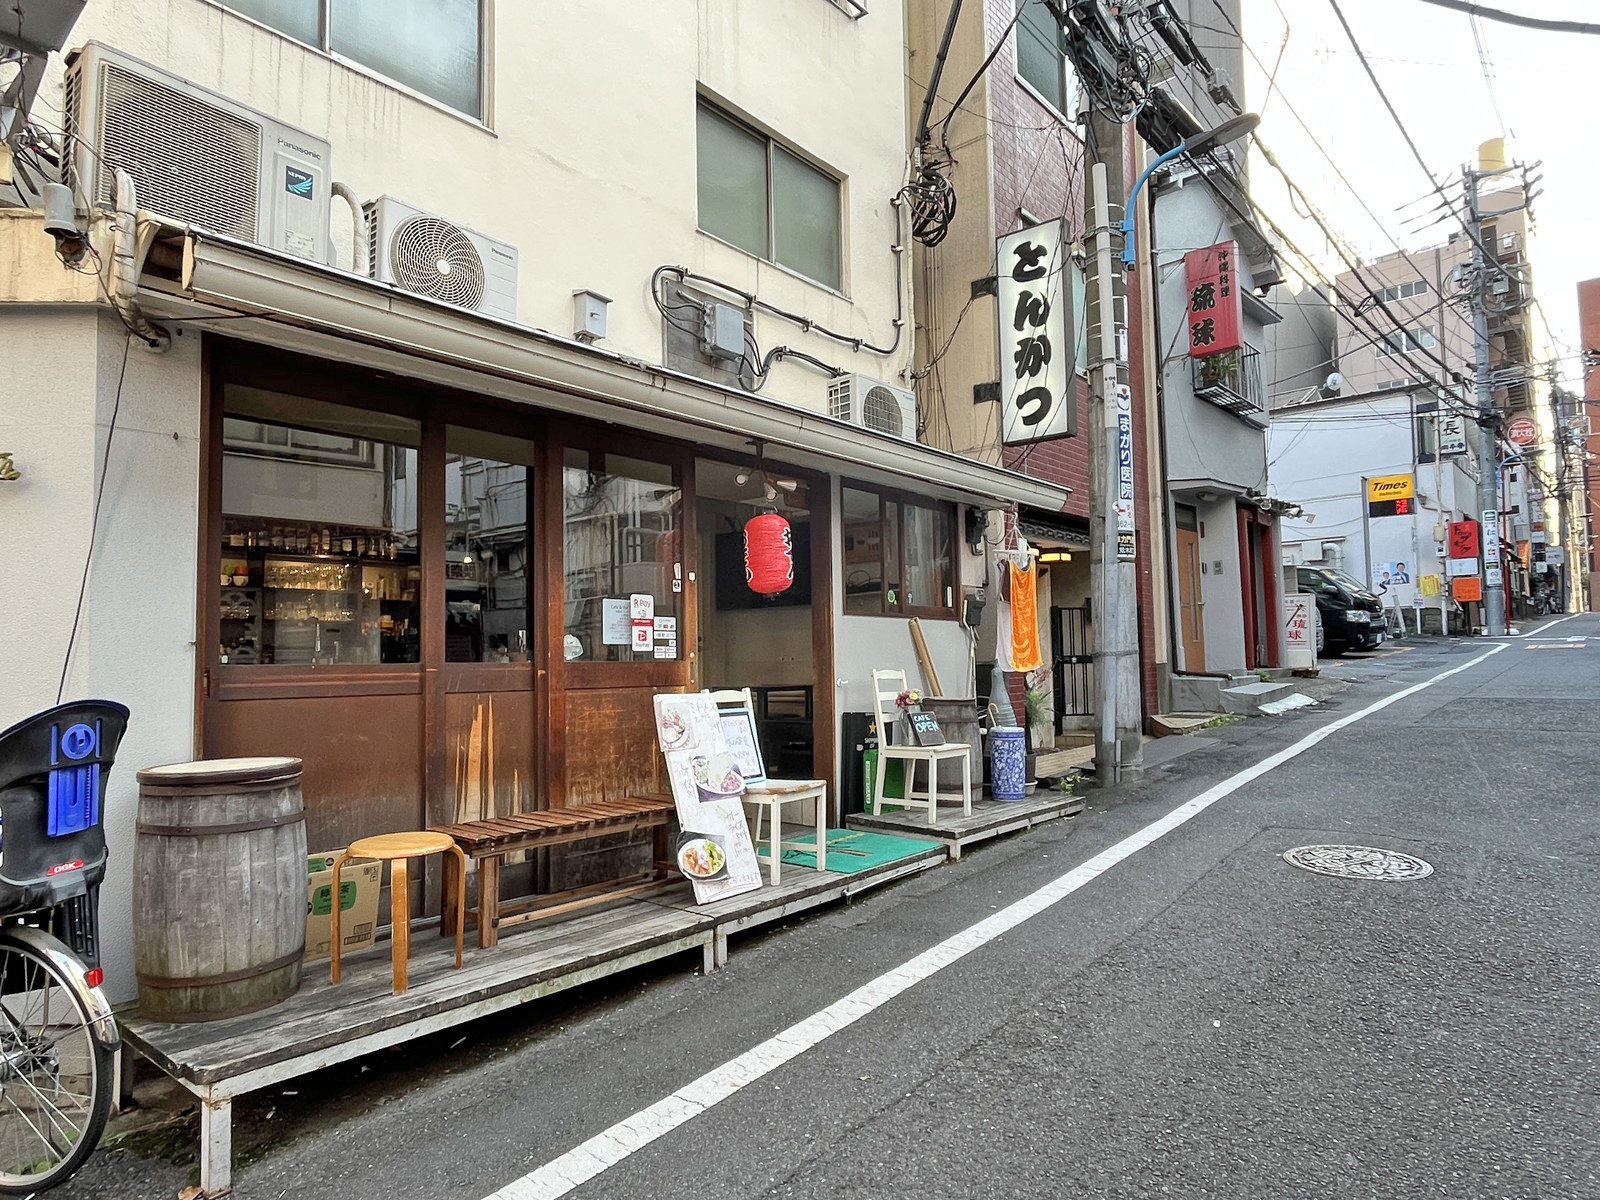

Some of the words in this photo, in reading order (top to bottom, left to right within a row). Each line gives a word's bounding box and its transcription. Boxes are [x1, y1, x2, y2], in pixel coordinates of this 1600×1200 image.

[277, 137, 321, 161] Panasonic
[1191, 282, 1216, 347] 琉球
[1012, 240, 1053, 427] とんかつ
[1372, 481, 1408, 492] Times
[913, 714, 931, 722] CAFE
[915, 721, 940, 733] OPEN
